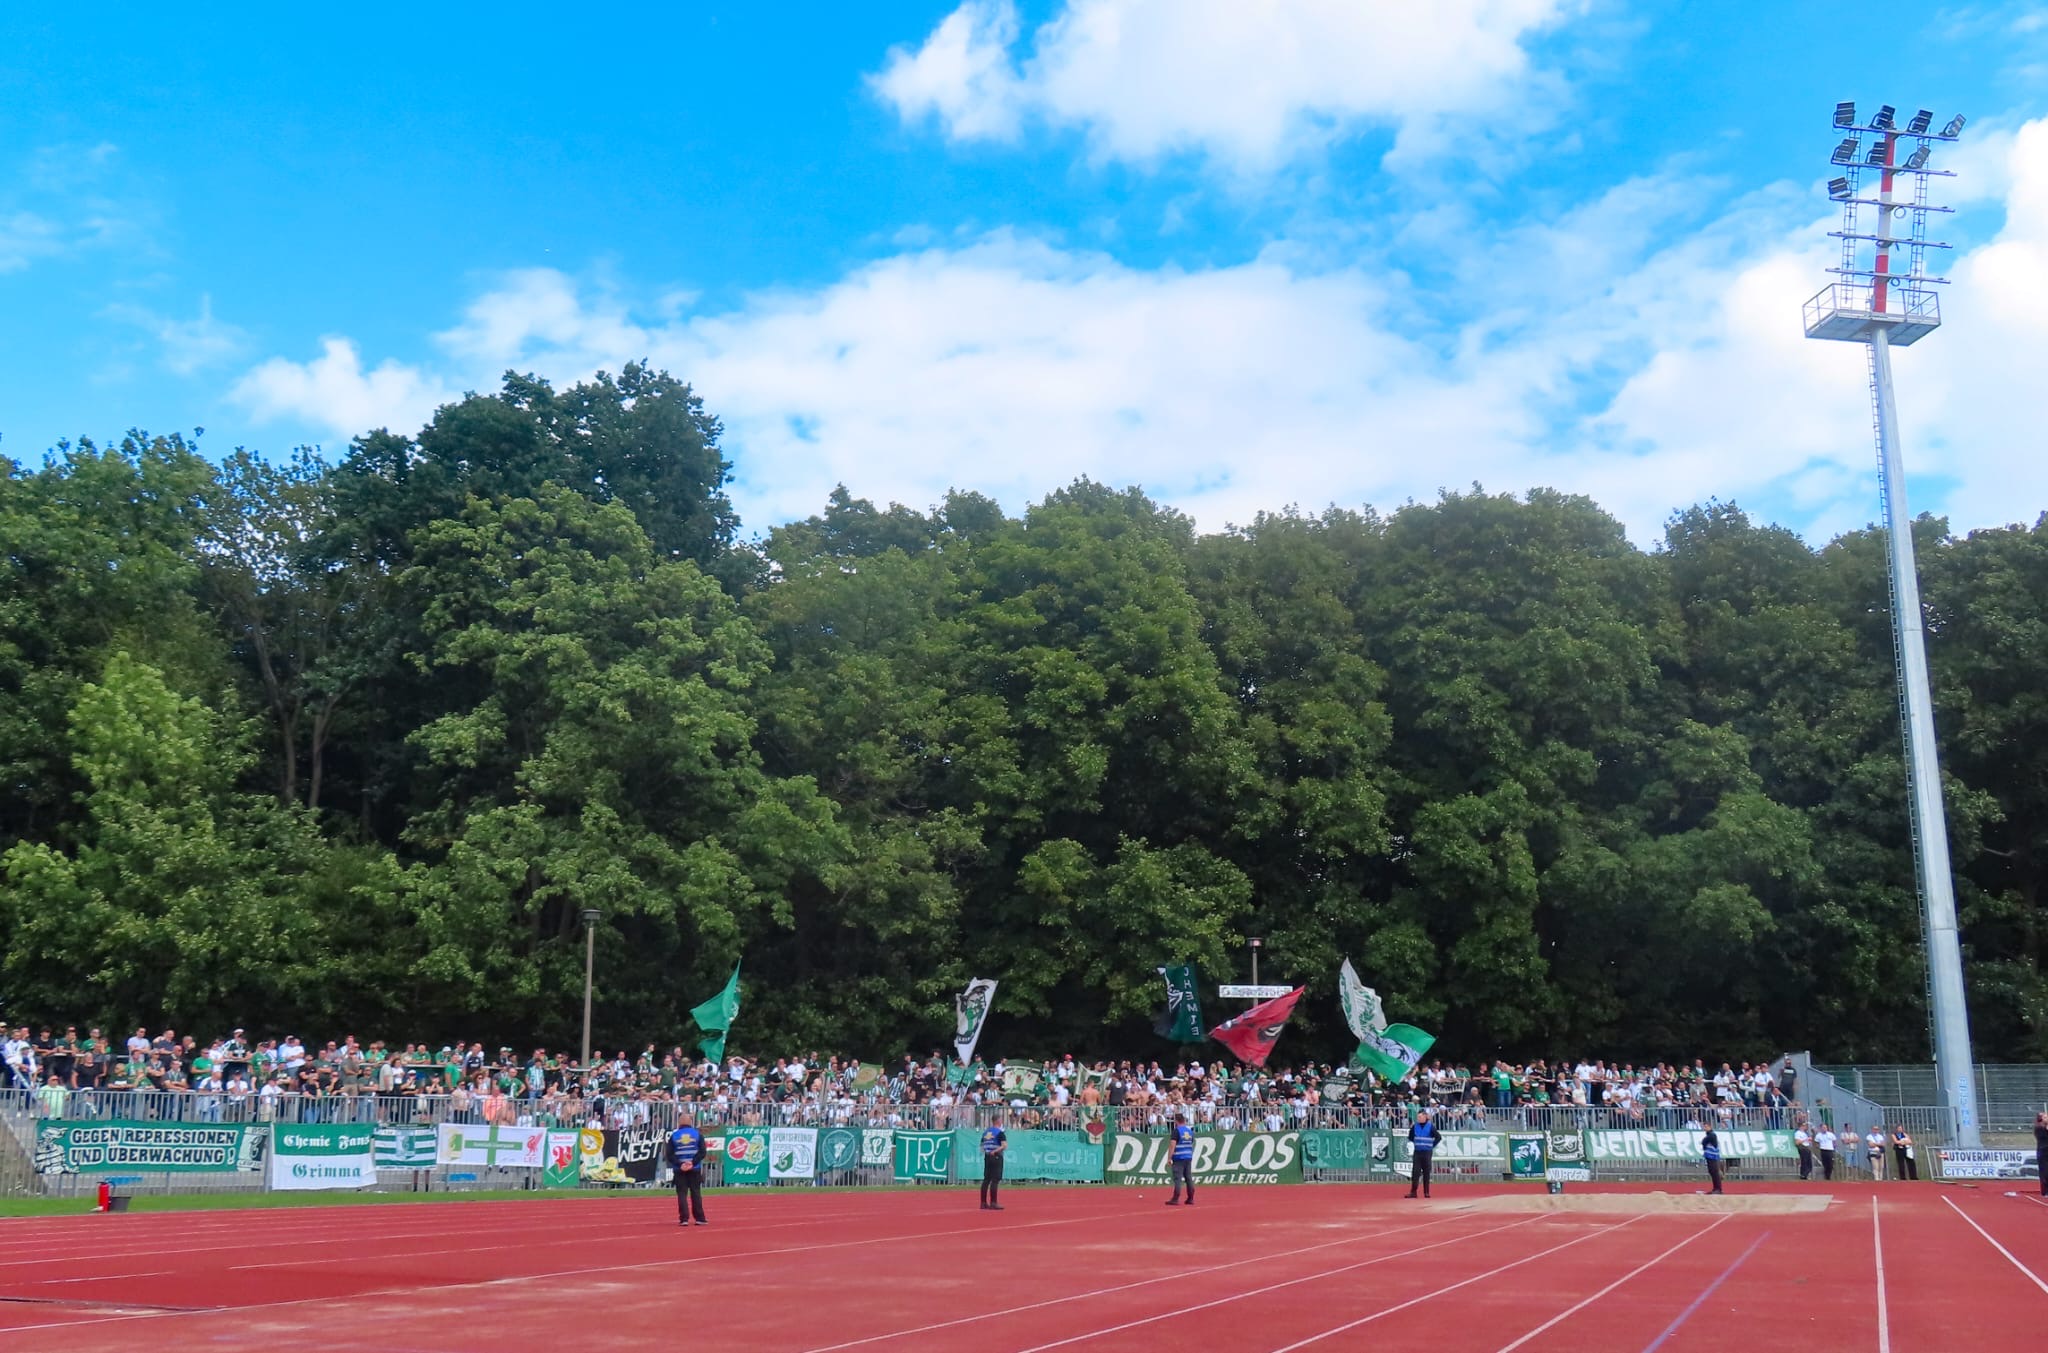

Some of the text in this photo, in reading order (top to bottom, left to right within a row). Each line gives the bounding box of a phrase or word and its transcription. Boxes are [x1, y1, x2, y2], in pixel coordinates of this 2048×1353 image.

[72, 1129, 236, 1144] GEGEN REPRESSIONEN
[283, 1135, 370, 1149] Chemie Fans
[619, 1129, 665, 1142] FANCLUB
[71, 1148, 102, 1163] UND
[107, 1143, 224, 1163] ÜBERWACHUNG
[618, 1142, 661, 1162] WEST
[1943, 1151, 2022, 1162] AUTOVERMIETUNG
[292, 1163, 361, 1178] Grimma
[1944, 1167, 1995, 1177] CITY-CAR
[1230, 1173, 1279, 1184] LEIPZIG
